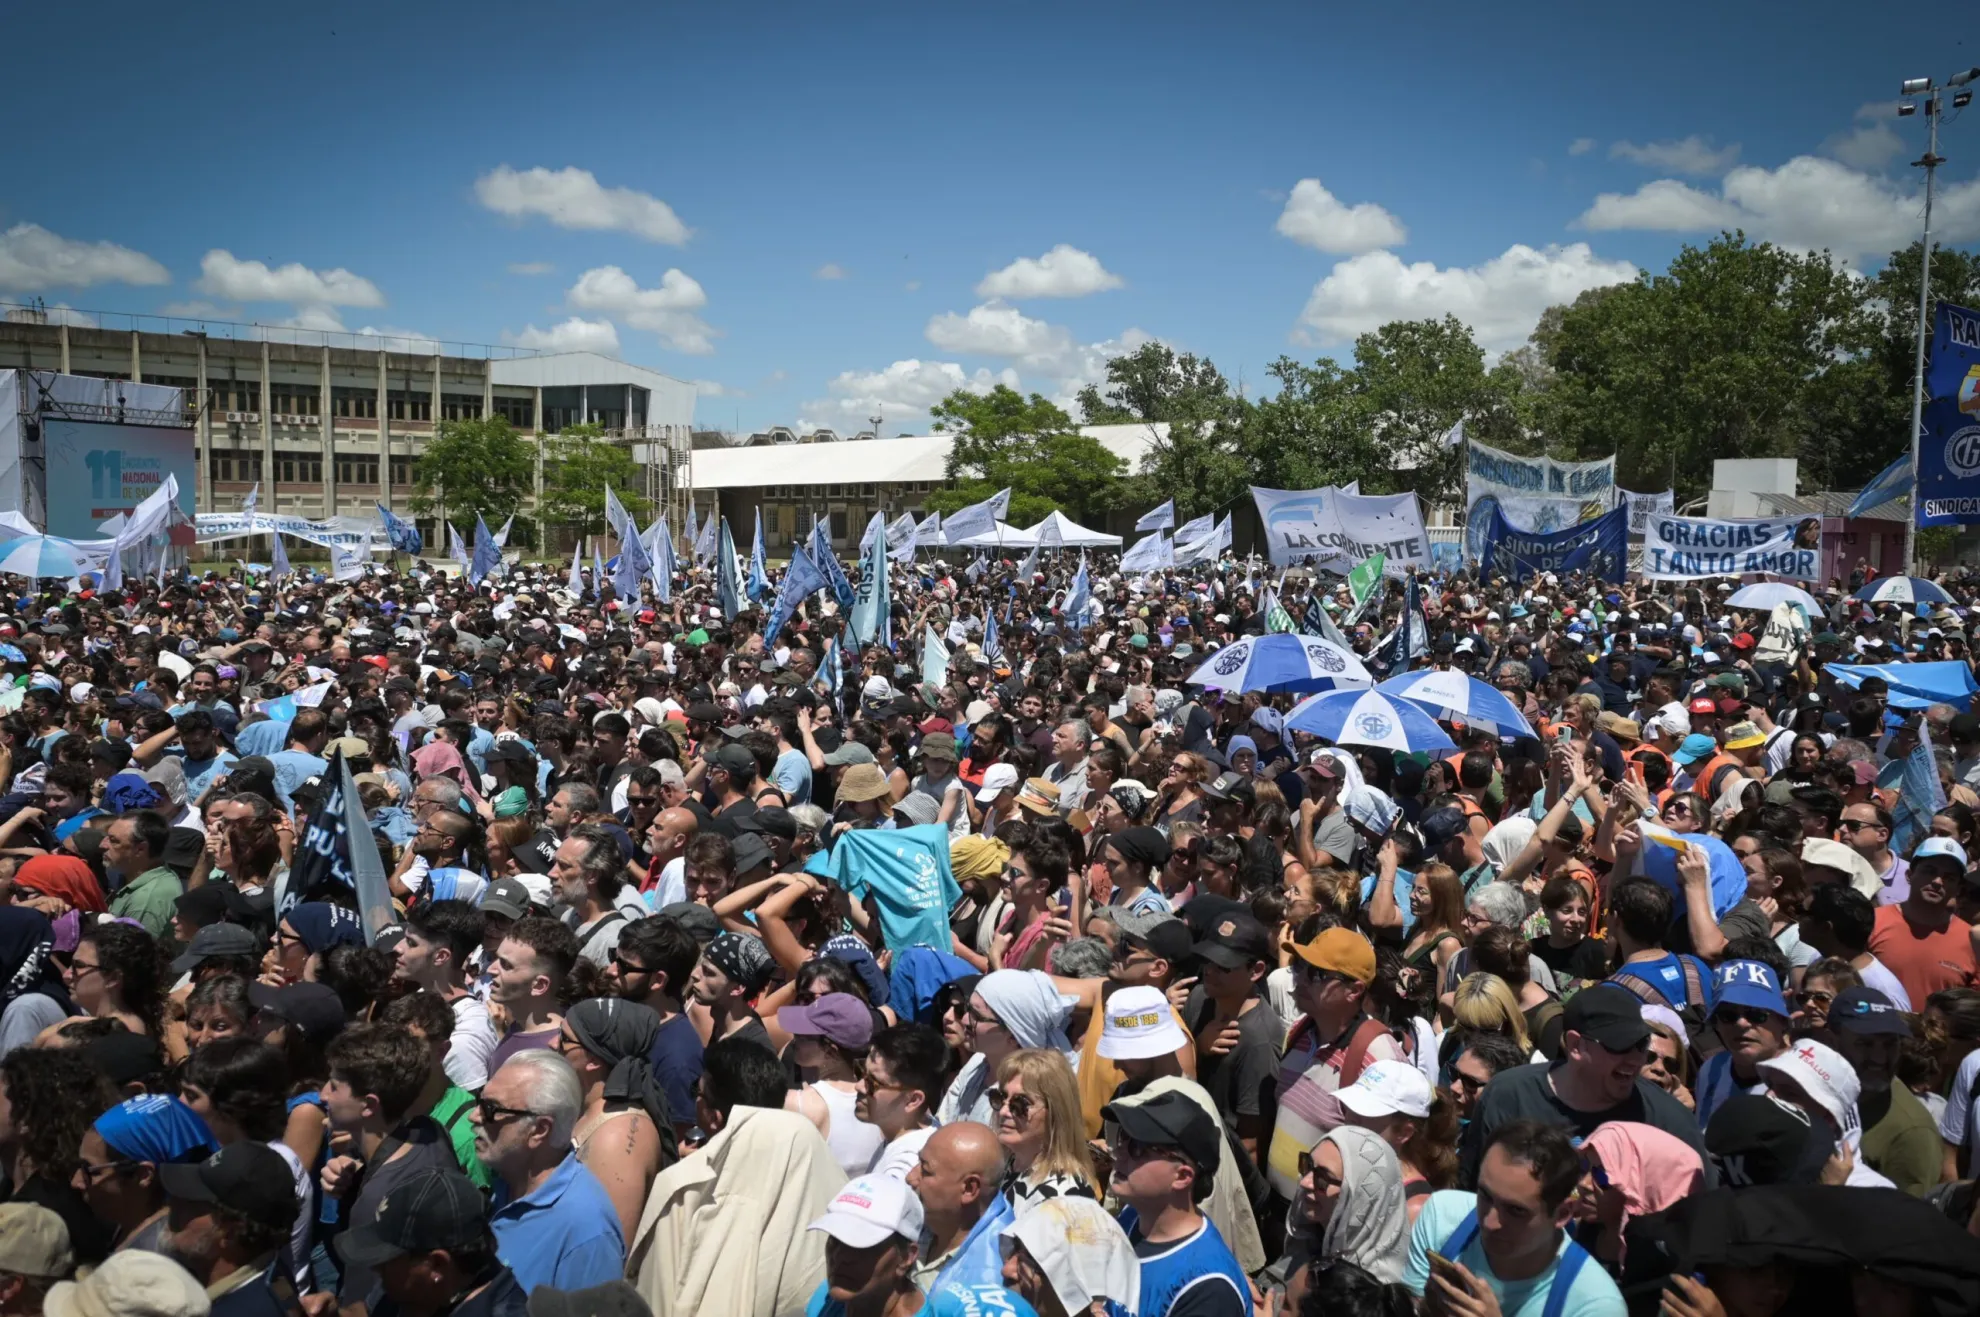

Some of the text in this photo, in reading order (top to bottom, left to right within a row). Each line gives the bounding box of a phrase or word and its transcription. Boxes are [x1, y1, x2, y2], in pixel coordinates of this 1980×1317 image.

[85, 450, 121, 499] 11
[122, 472, 160, 484] NACIONAL
[123, 487, 132, 499] DE
[1925, 498, 1980, 517] SINDICA
[1284, 532, 1423, 560] LA CORRIENTE
[1505, 529, 1600, 556] SINDICATO
[1658, 519, 1773, 548] GRACIAS
[1541, 555, 1563, 570] DE
[1651, 547, 1815, 576] TANTO AMOR
[1711, 962, 1773, 990] CFK
[1114, 1015, 1139, 1028] DESDE
[1803, 1055, 1831, 1082] SALUD
